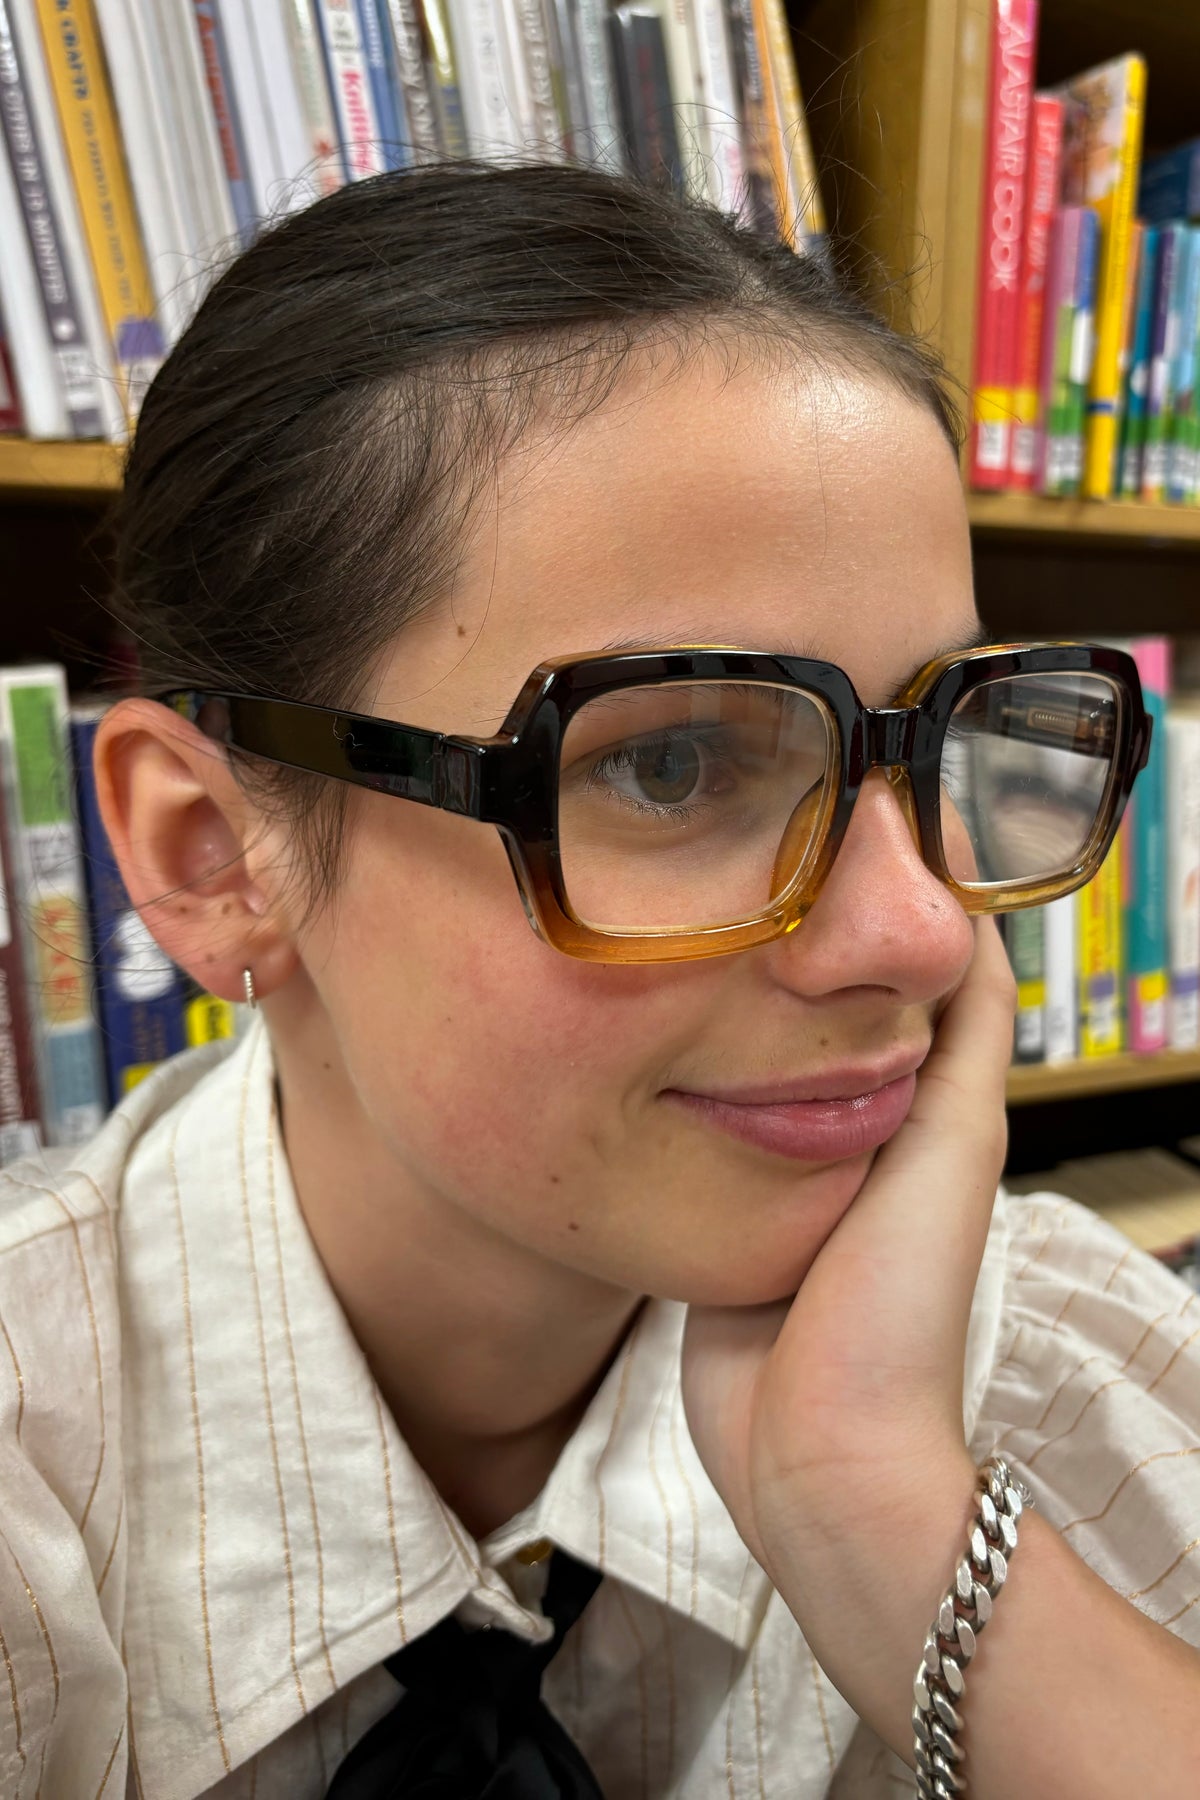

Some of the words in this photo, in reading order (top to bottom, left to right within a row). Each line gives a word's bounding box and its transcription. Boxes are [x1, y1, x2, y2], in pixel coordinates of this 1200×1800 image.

[996, 19, 1031, 177] ALASTAIR
[31, 217, 68, 304] MINUTES
[989, 178, 1024, 292] COOK
